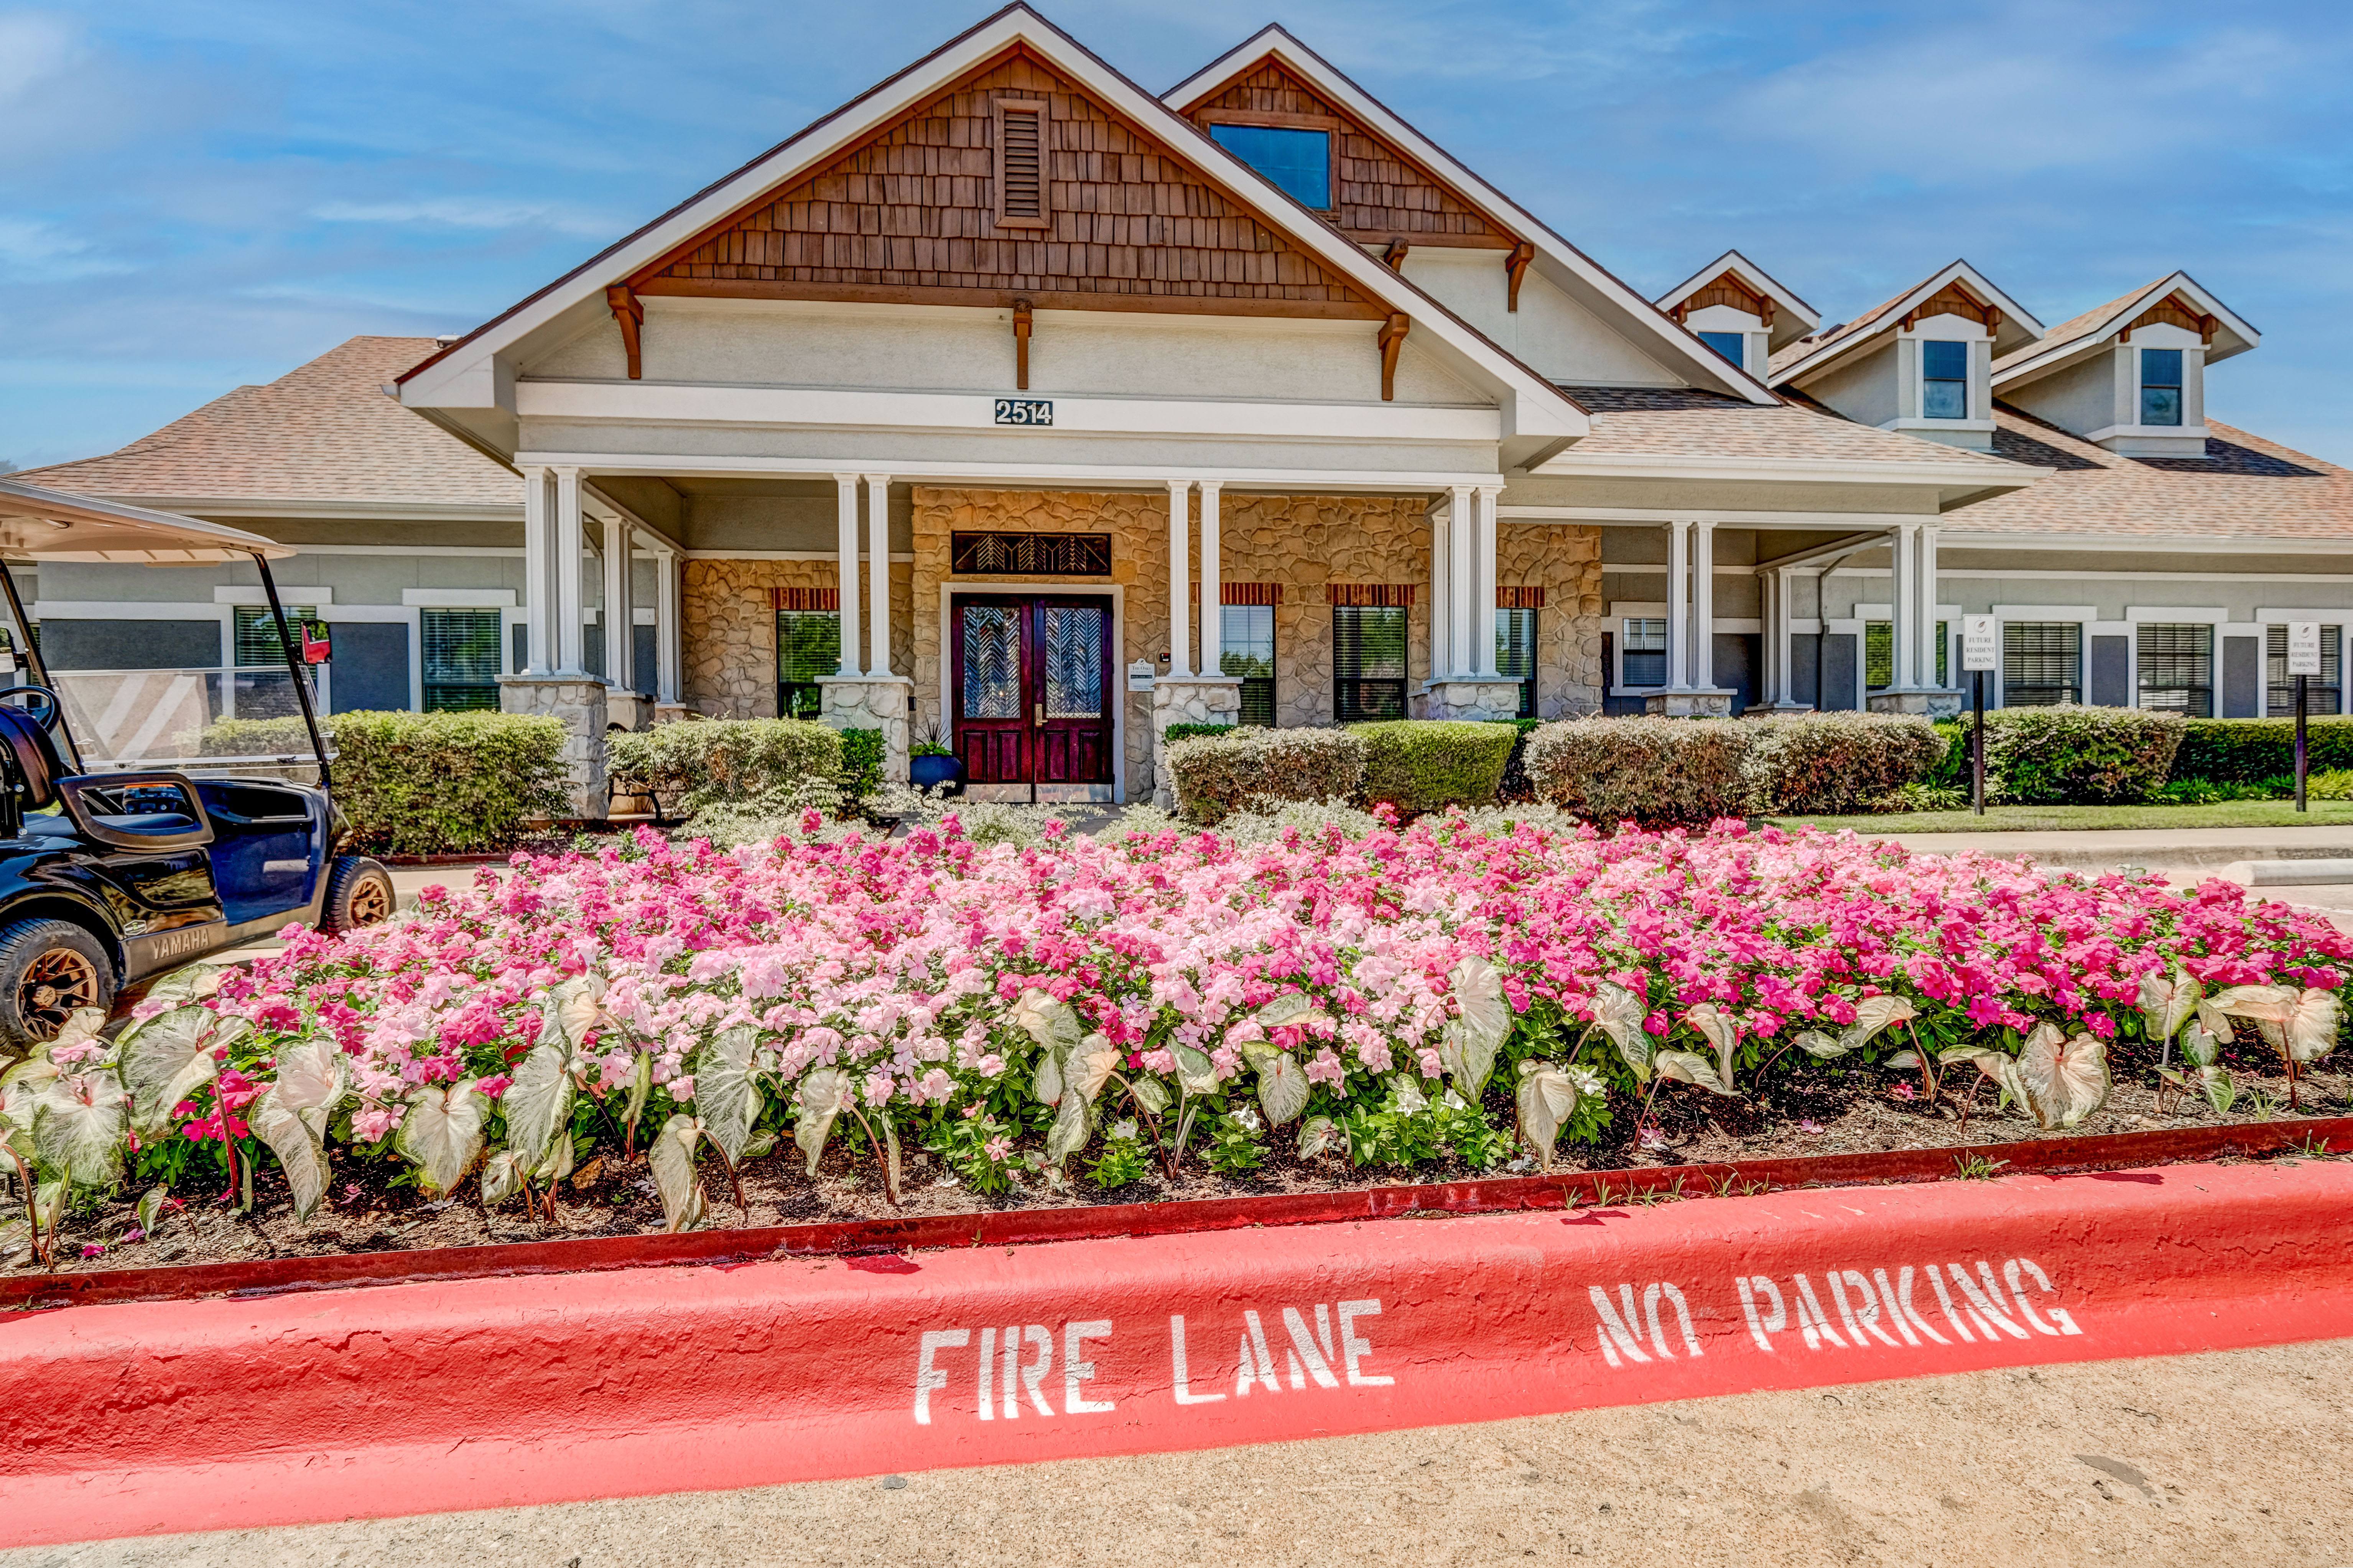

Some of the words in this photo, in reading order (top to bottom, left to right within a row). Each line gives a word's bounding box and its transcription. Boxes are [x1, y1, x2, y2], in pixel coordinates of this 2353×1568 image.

[996, 401, 1051, 424] 2514
[153, 928, 209, 960] YAMAHA
[1588, 1281, 1704, 1367] NO
[1735, 1257, 2083, 1352] PARKING
[914, 1319, 1115, 1425] FIRE
[1170, 1298, 1395, 1405] LANE
